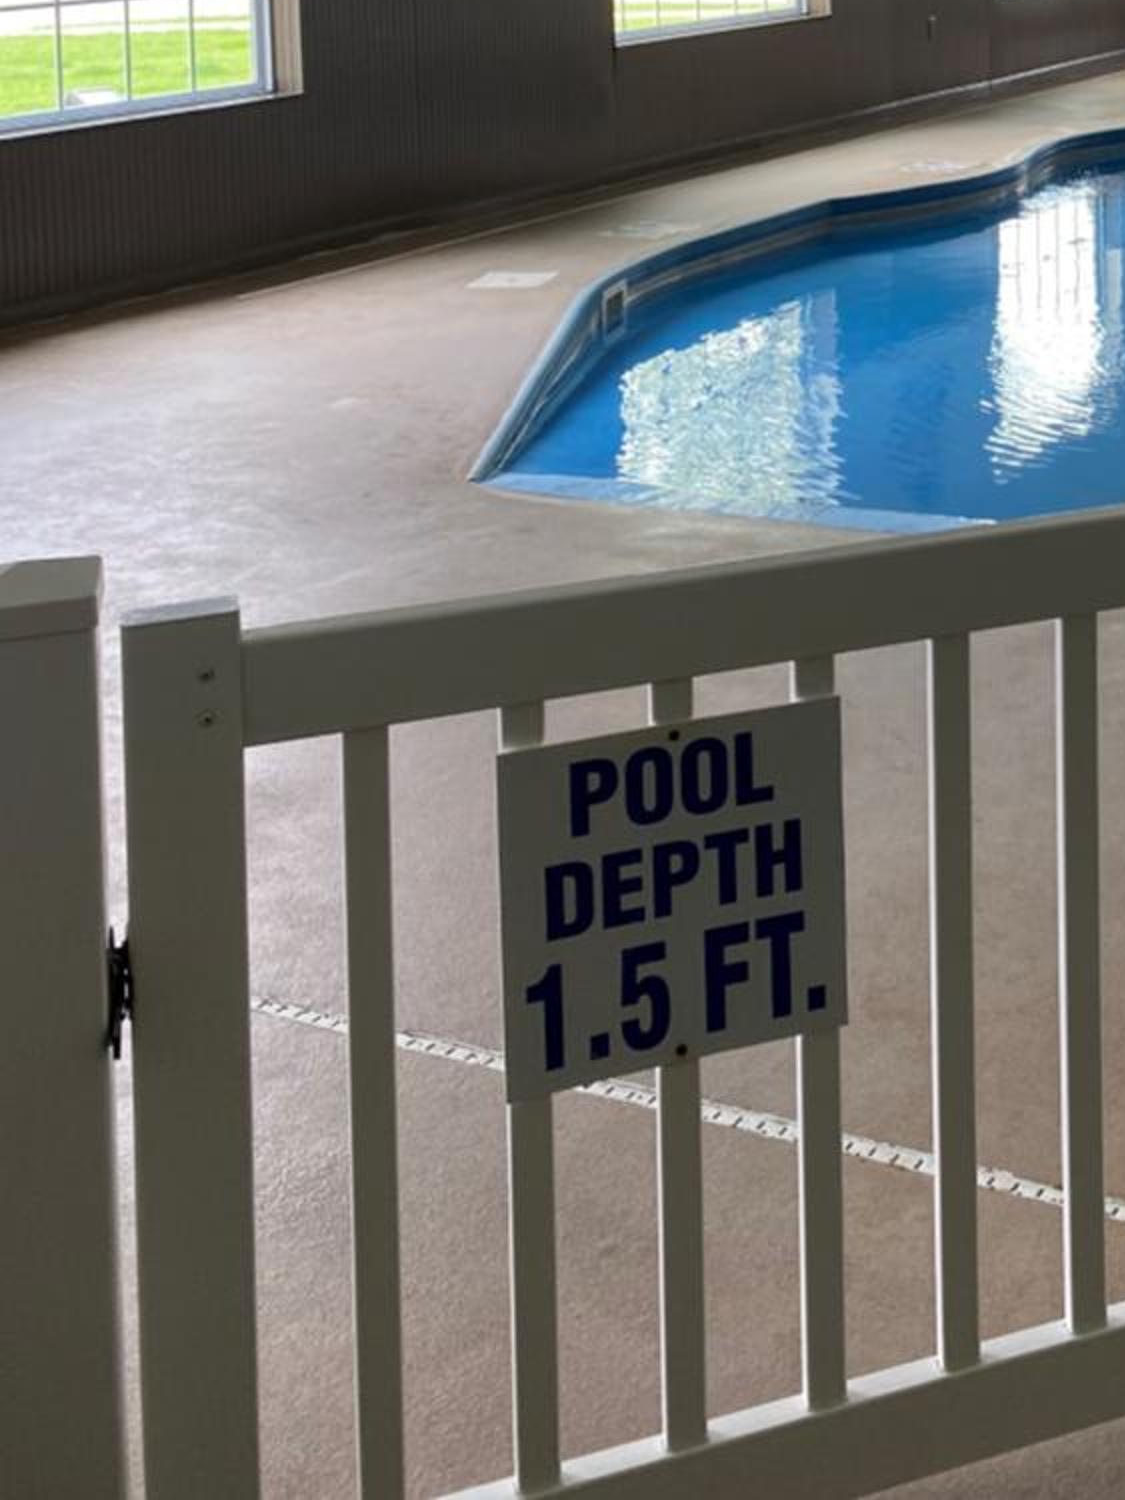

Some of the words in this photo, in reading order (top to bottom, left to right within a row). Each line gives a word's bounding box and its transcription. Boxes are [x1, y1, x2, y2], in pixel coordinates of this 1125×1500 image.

[569, 731, 775, 839] POOL
[543, 818, 803, 943] DEPTH
[525, 941, 672, 1072] 1.5
[703, 910, 827, 1034] FT.
